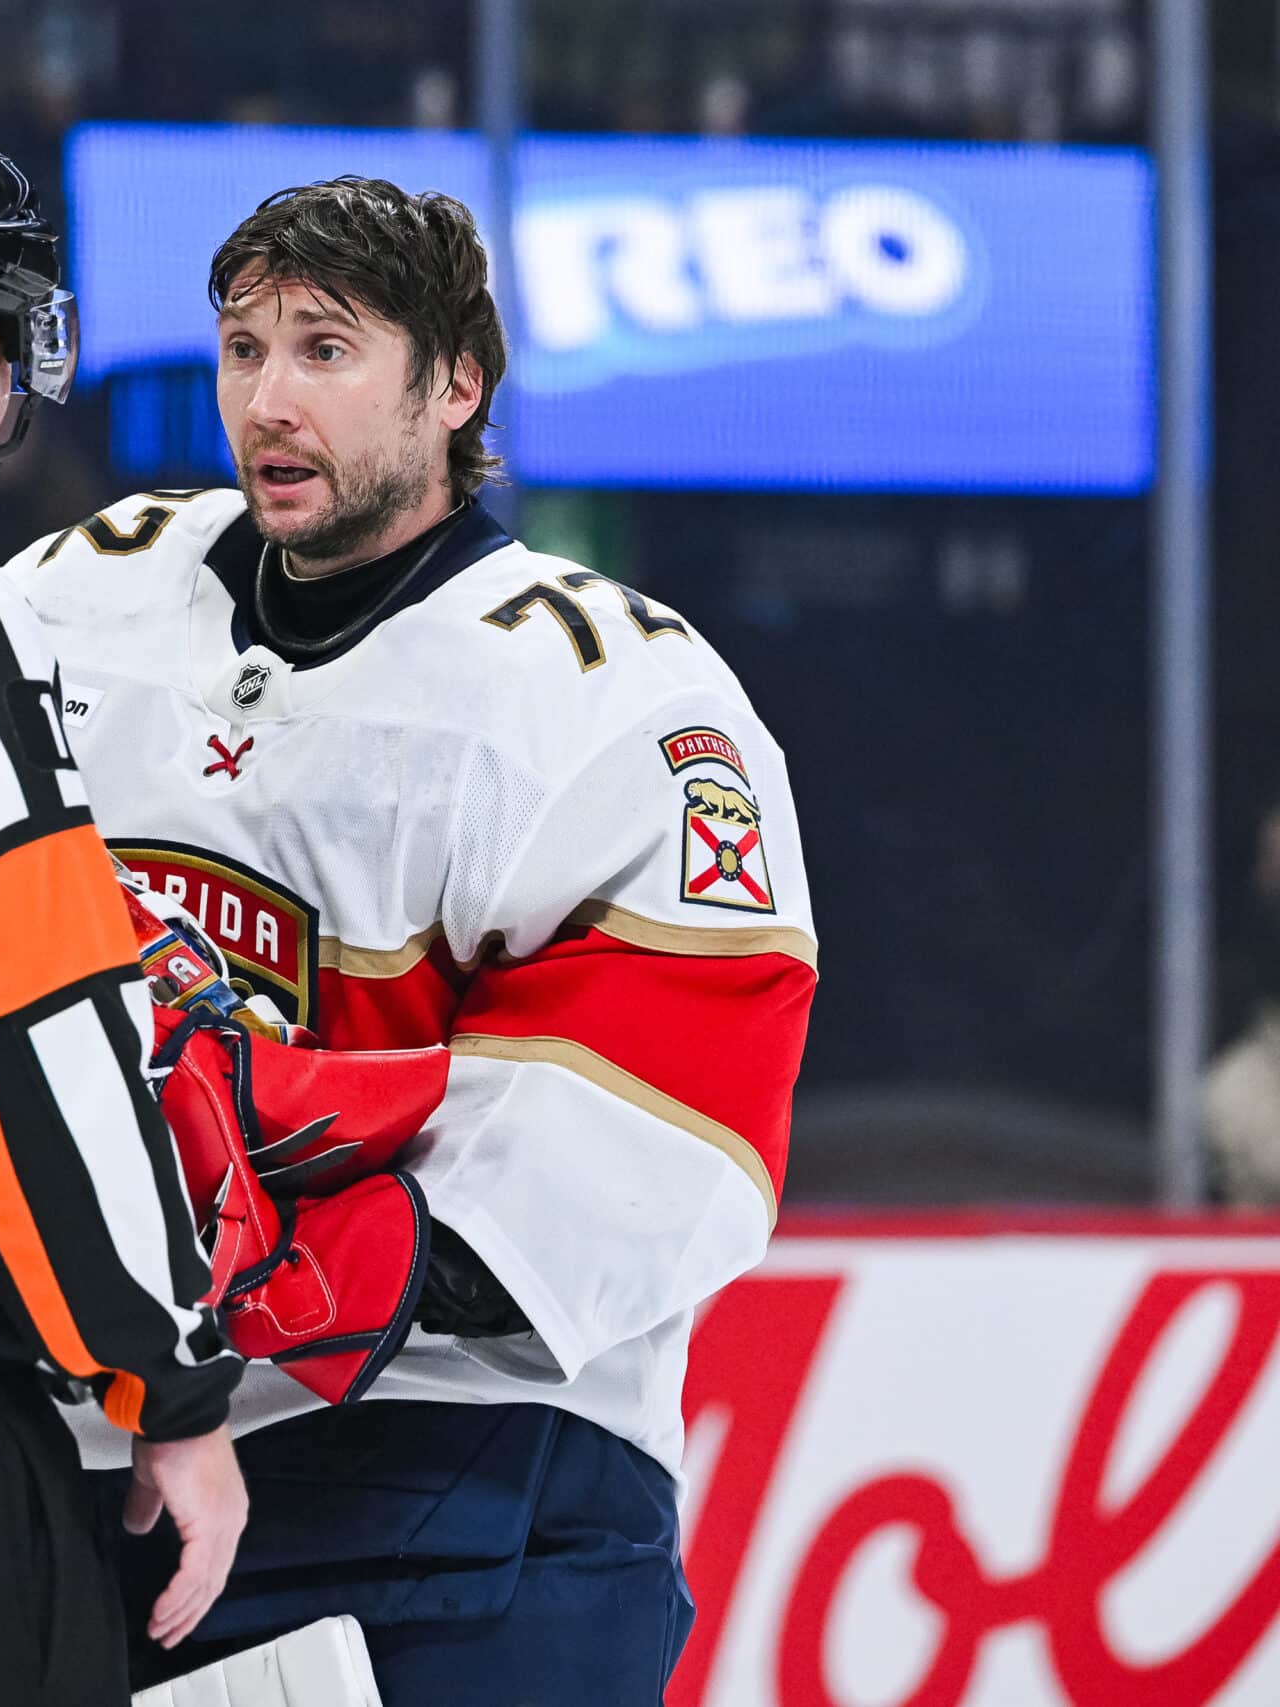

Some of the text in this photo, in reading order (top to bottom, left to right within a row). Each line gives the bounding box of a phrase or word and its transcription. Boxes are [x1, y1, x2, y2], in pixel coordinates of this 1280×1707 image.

[511, 185, 968, 352] REO
[480, 571, 692, 674] 72
[65, 700, 89, 716] on
[237, 676, 263, 698] NHL
